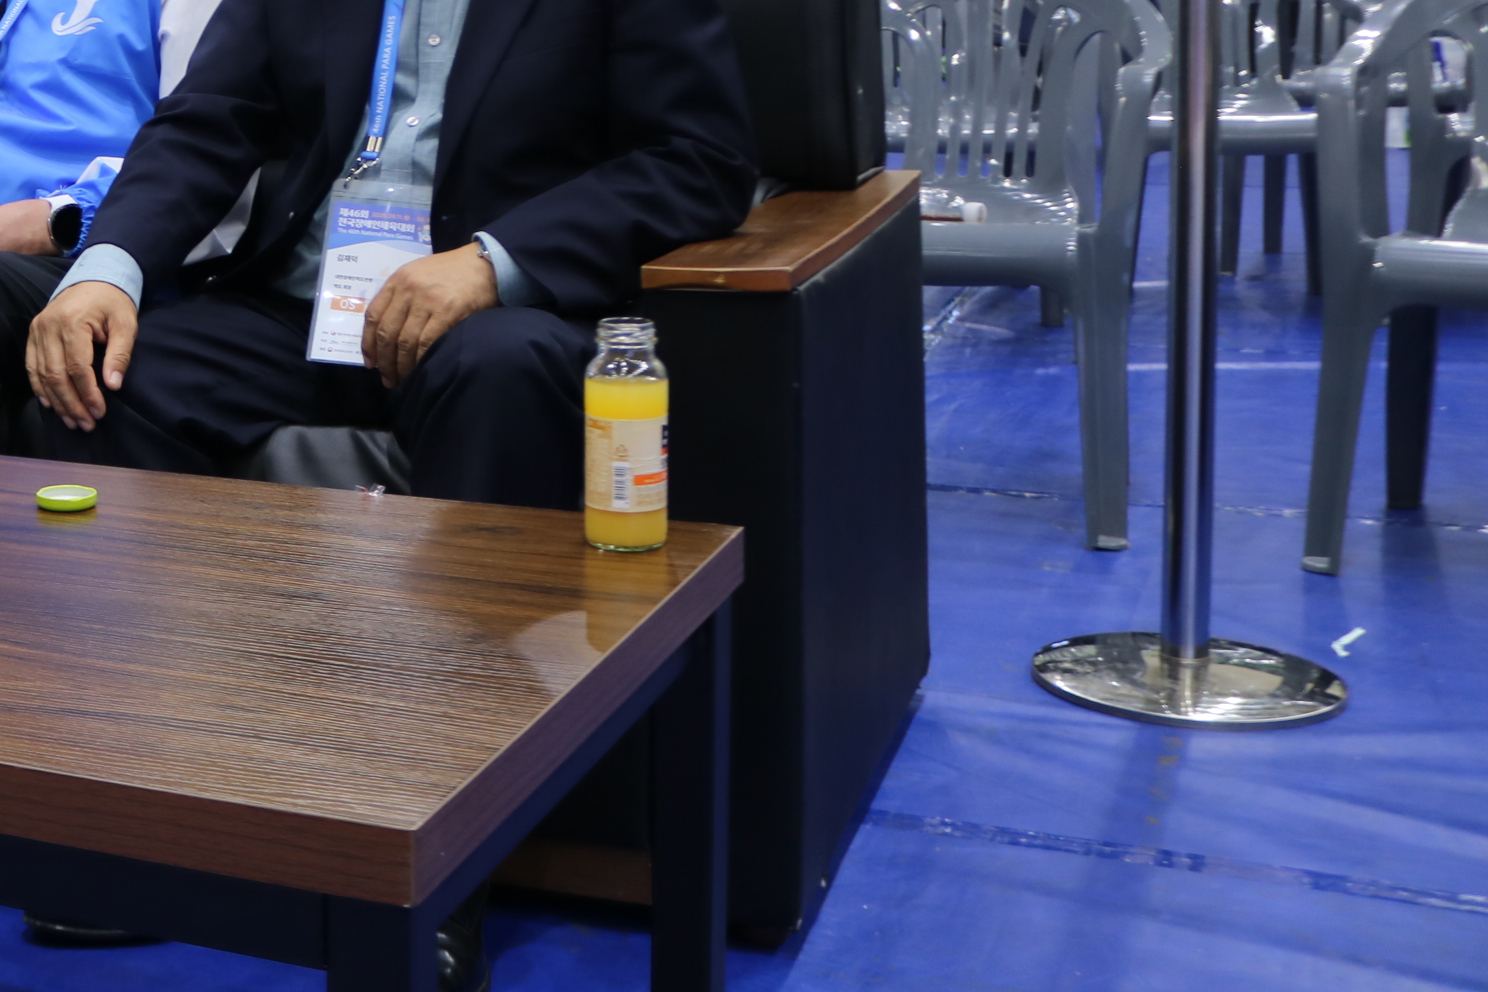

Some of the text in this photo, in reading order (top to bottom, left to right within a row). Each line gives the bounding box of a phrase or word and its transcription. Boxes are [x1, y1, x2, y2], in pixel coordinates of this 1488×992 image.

[1, 0, 25, 31] NATIONAL
[385, 15, 396, 45] GAMES
[381, 47, 392, 69] PARA
[376, 71, 389, 114] NATIONAL
